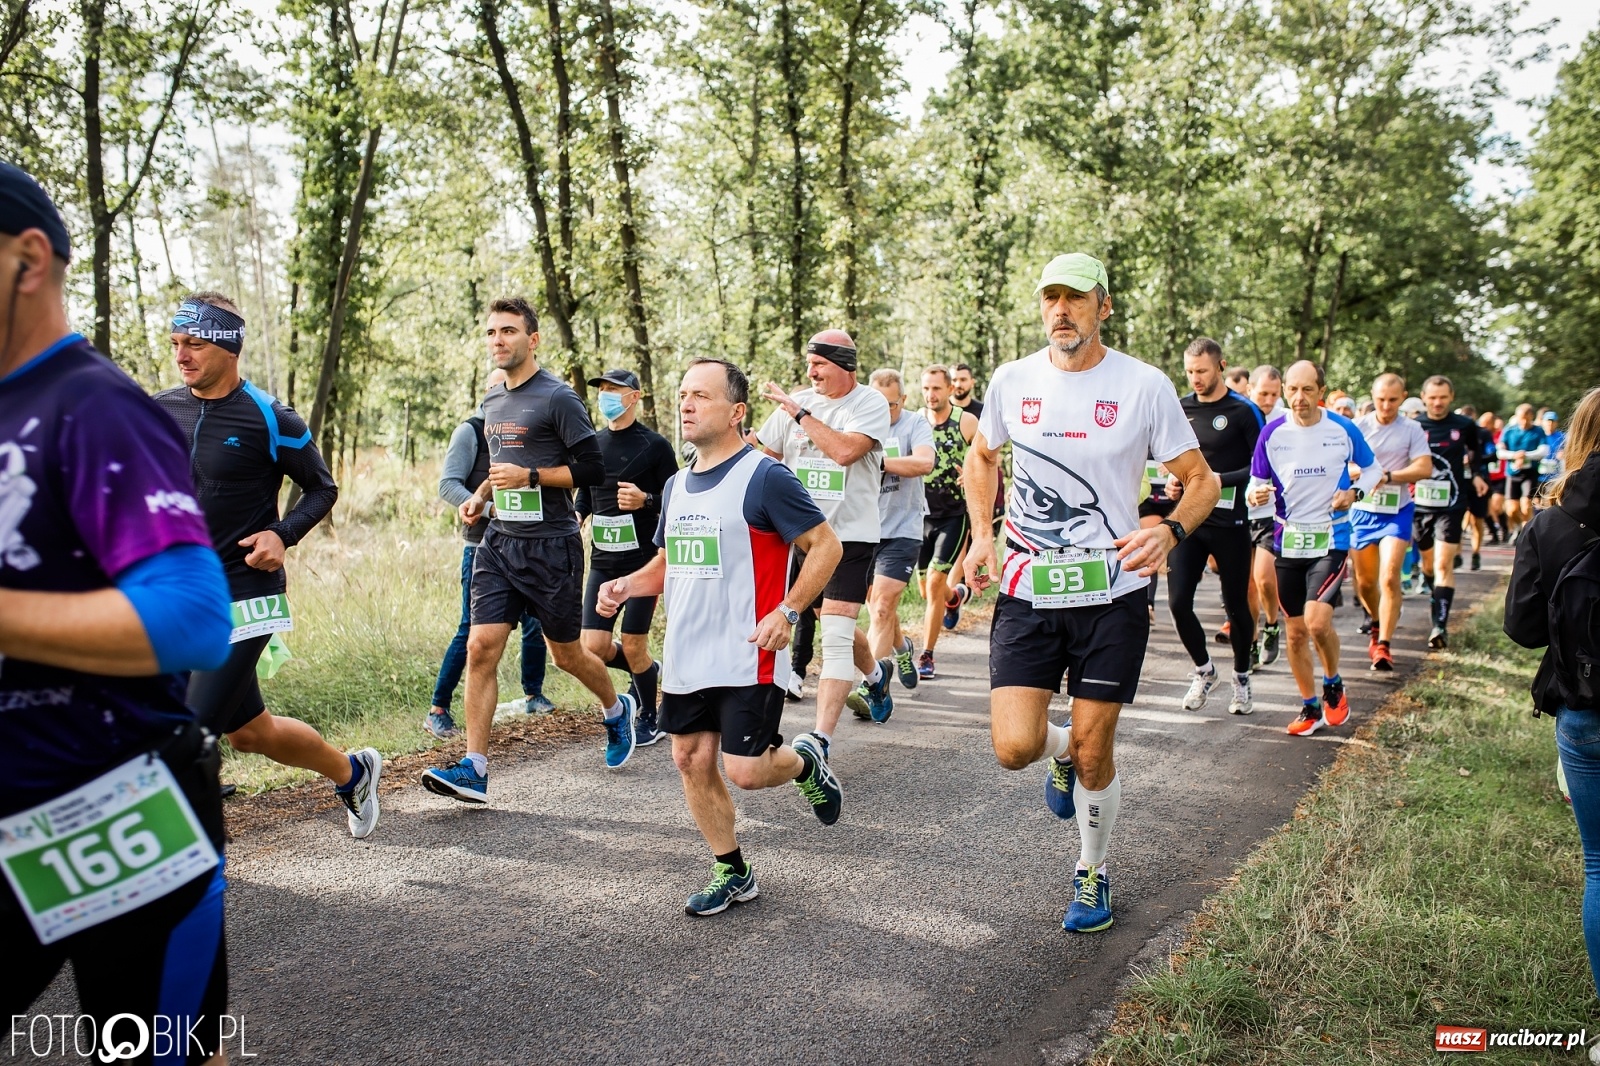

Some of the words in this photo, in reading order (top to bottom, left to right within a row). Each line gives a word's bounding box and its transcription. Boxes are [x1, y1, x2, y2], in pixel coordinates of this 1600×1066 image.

[807, 471, 831, 489] 88
[1294, 466, 1326, 475] marek
[503, 491, 522, 510] 13
[603, 527, 621, 543] 47
[1293, 533, 1316, 549] 33
[674, 539, 705, 564] 170
[1046, 550, 1054, 564] V
[1048, 566, 1085, 593] 93
[236, 594, 283, 623] 102
[30, 810, 53, 839] V
[39, 810, 162, 896] 166
